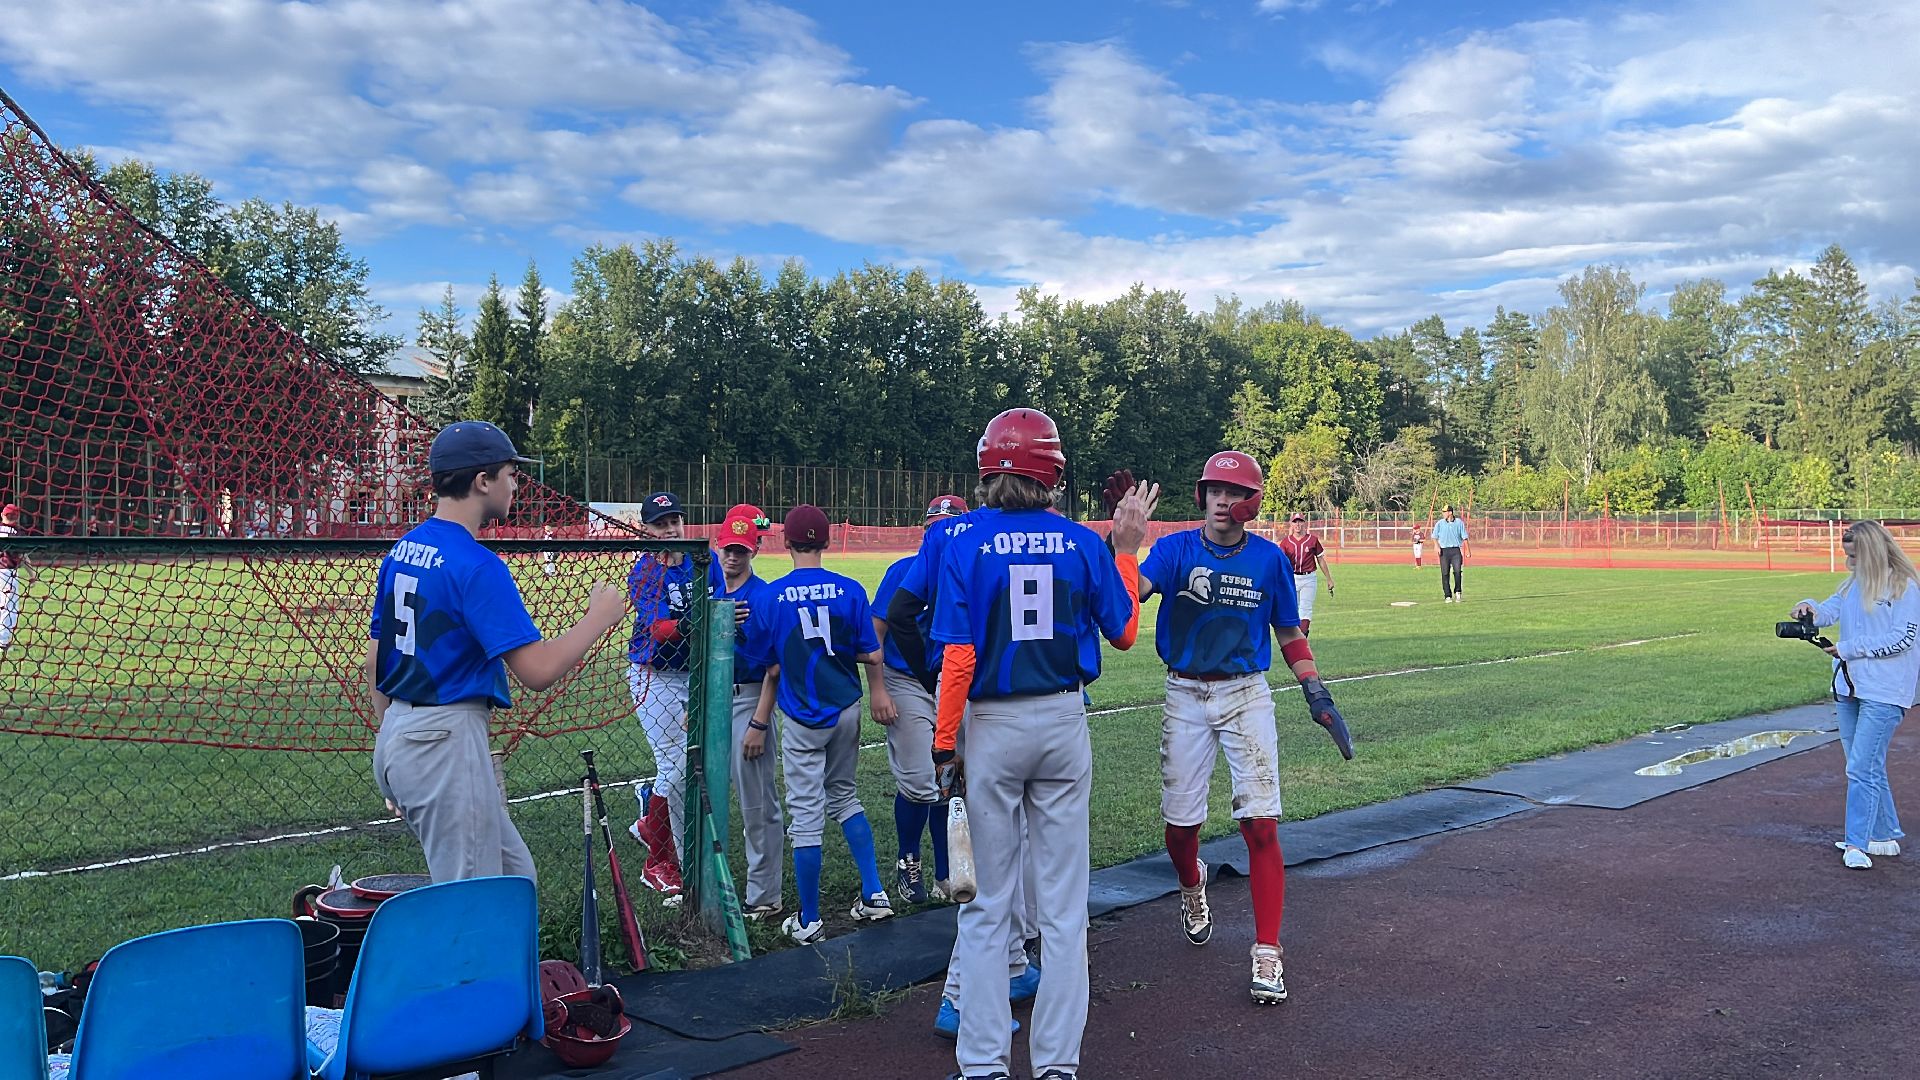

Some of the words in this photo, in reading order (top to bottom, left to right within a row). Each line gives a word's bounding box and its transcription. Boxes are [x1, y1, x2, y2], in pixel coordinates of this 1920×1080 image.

[394, 540, 438, 569] ОРЕЛ
[994, 532, 1065, 554] ОРЕЛ
[785, 583, 836, 602] ОРЕЛ
[1220, 574, 1253, 587] КУБОК
[394, 572, 418, 656] 5
[1009, 564, 1053, 641] 8
[798, 605, 836, 656] 4
[1870, 621, 1918, 658] HOLLISTER
